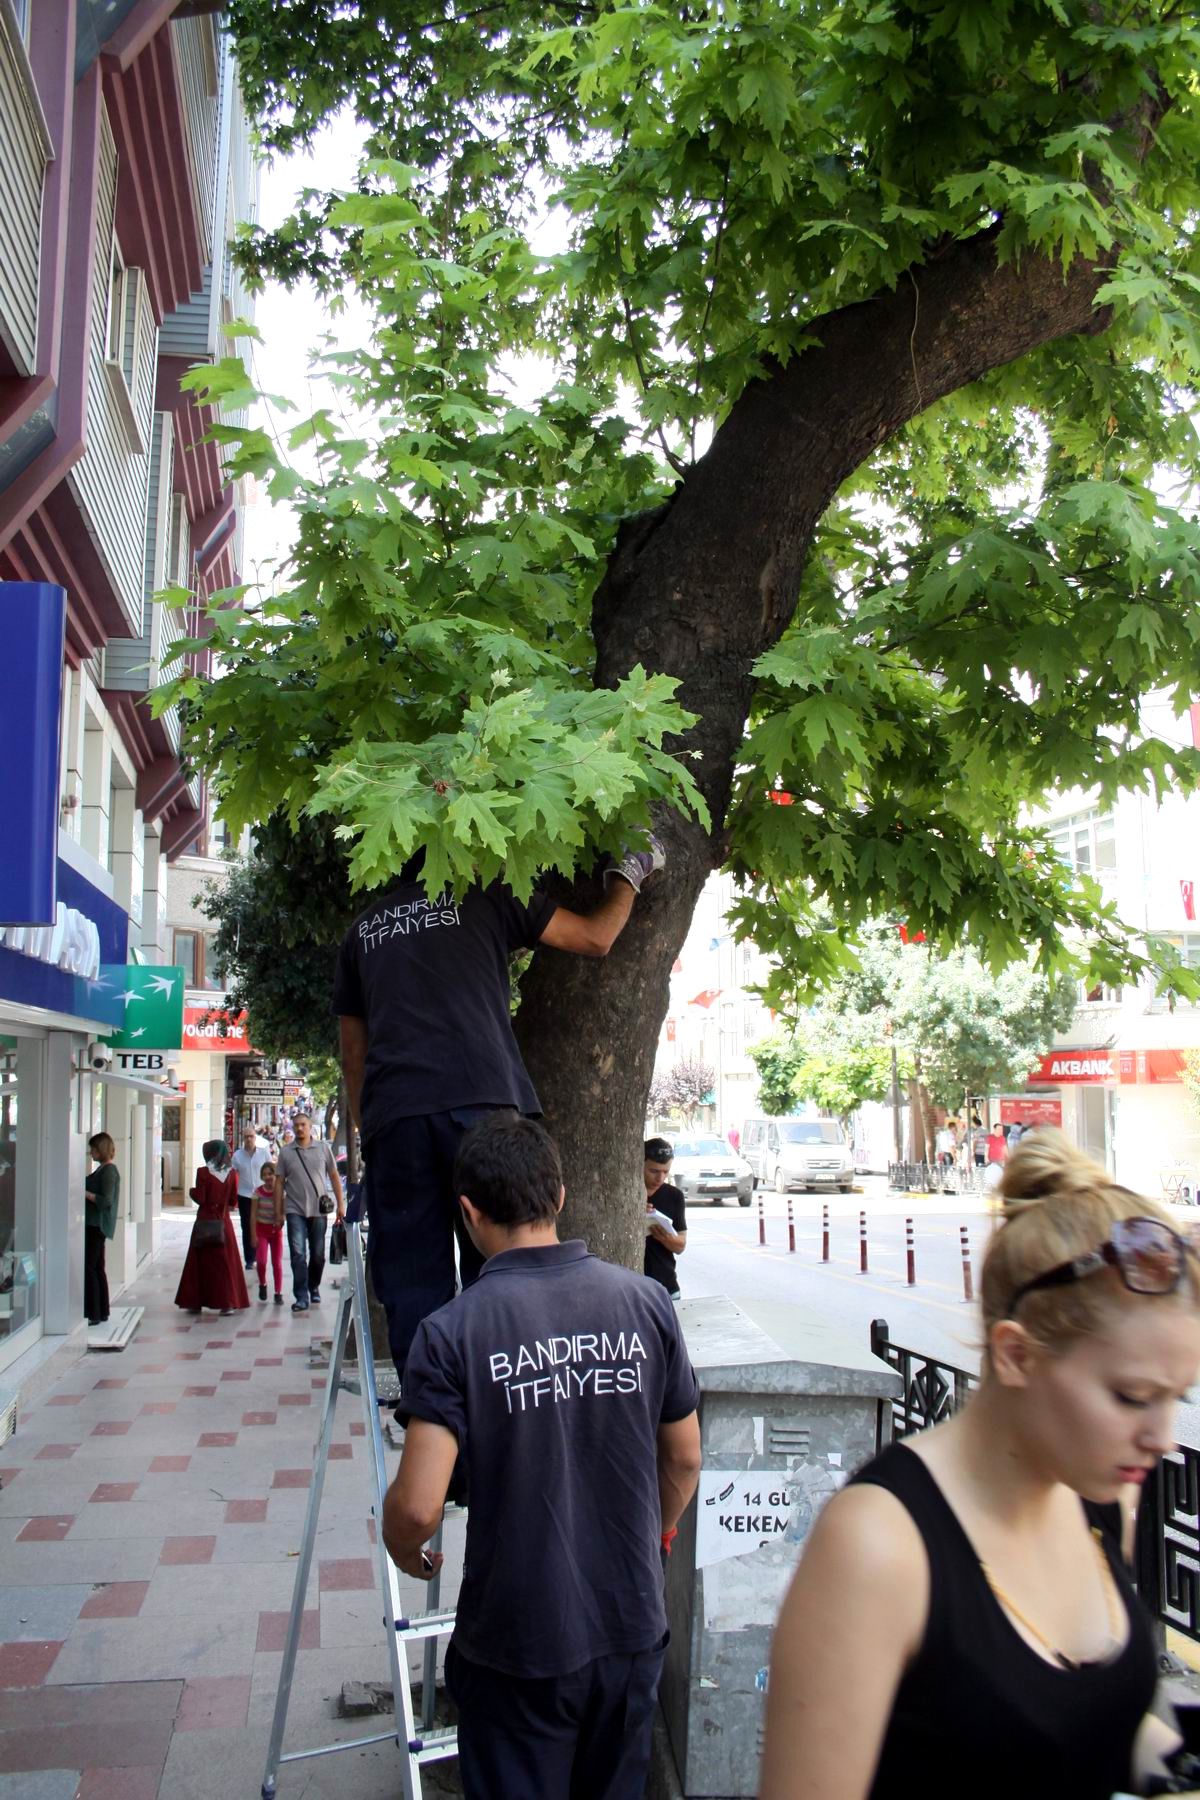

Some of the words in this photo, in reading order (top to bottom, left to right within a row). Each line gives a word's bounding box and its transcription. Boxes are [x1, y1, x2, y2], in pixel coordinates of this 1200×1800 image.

[116, 1053, 164, 1070] TEB
[1050, 1060, 1115, 1076] AKBANK
[489, 1332, 647, 1382] BANDIRMA
[504, 1362, 642, 1414] İTFAİYESİ
[744, 1492, 761, 1506] 14
